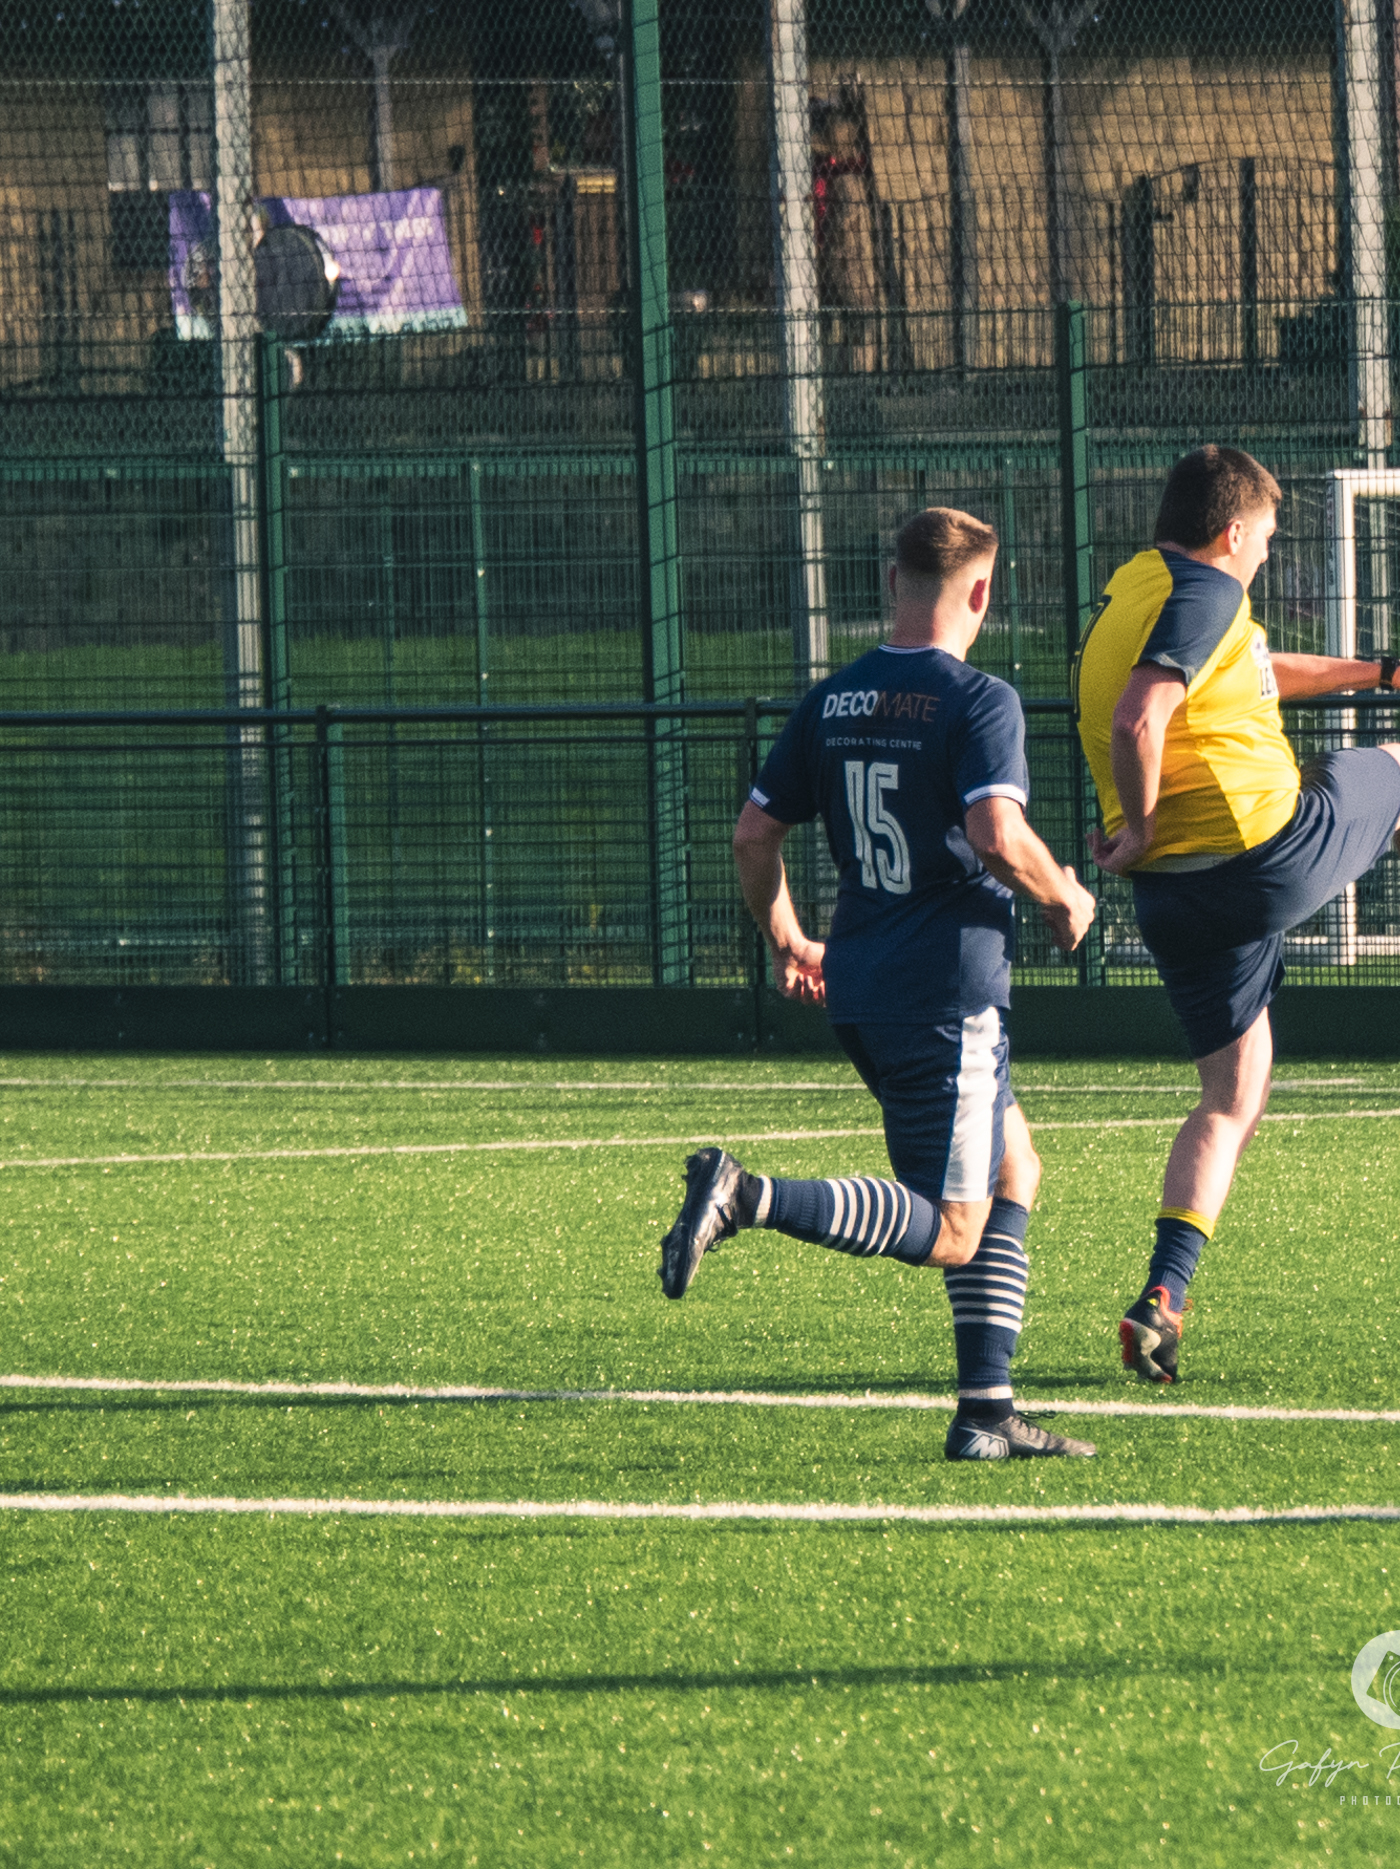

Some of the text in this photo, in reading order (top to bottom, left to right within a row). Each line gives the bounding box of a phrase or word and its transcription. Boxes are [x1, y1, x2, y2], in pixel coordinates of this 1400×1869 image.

[822, 690, 941, 722] DECOMATE
[826, 736, 922, 750] DECORATING CENTRE
[844, 761, 912, 894] 15
